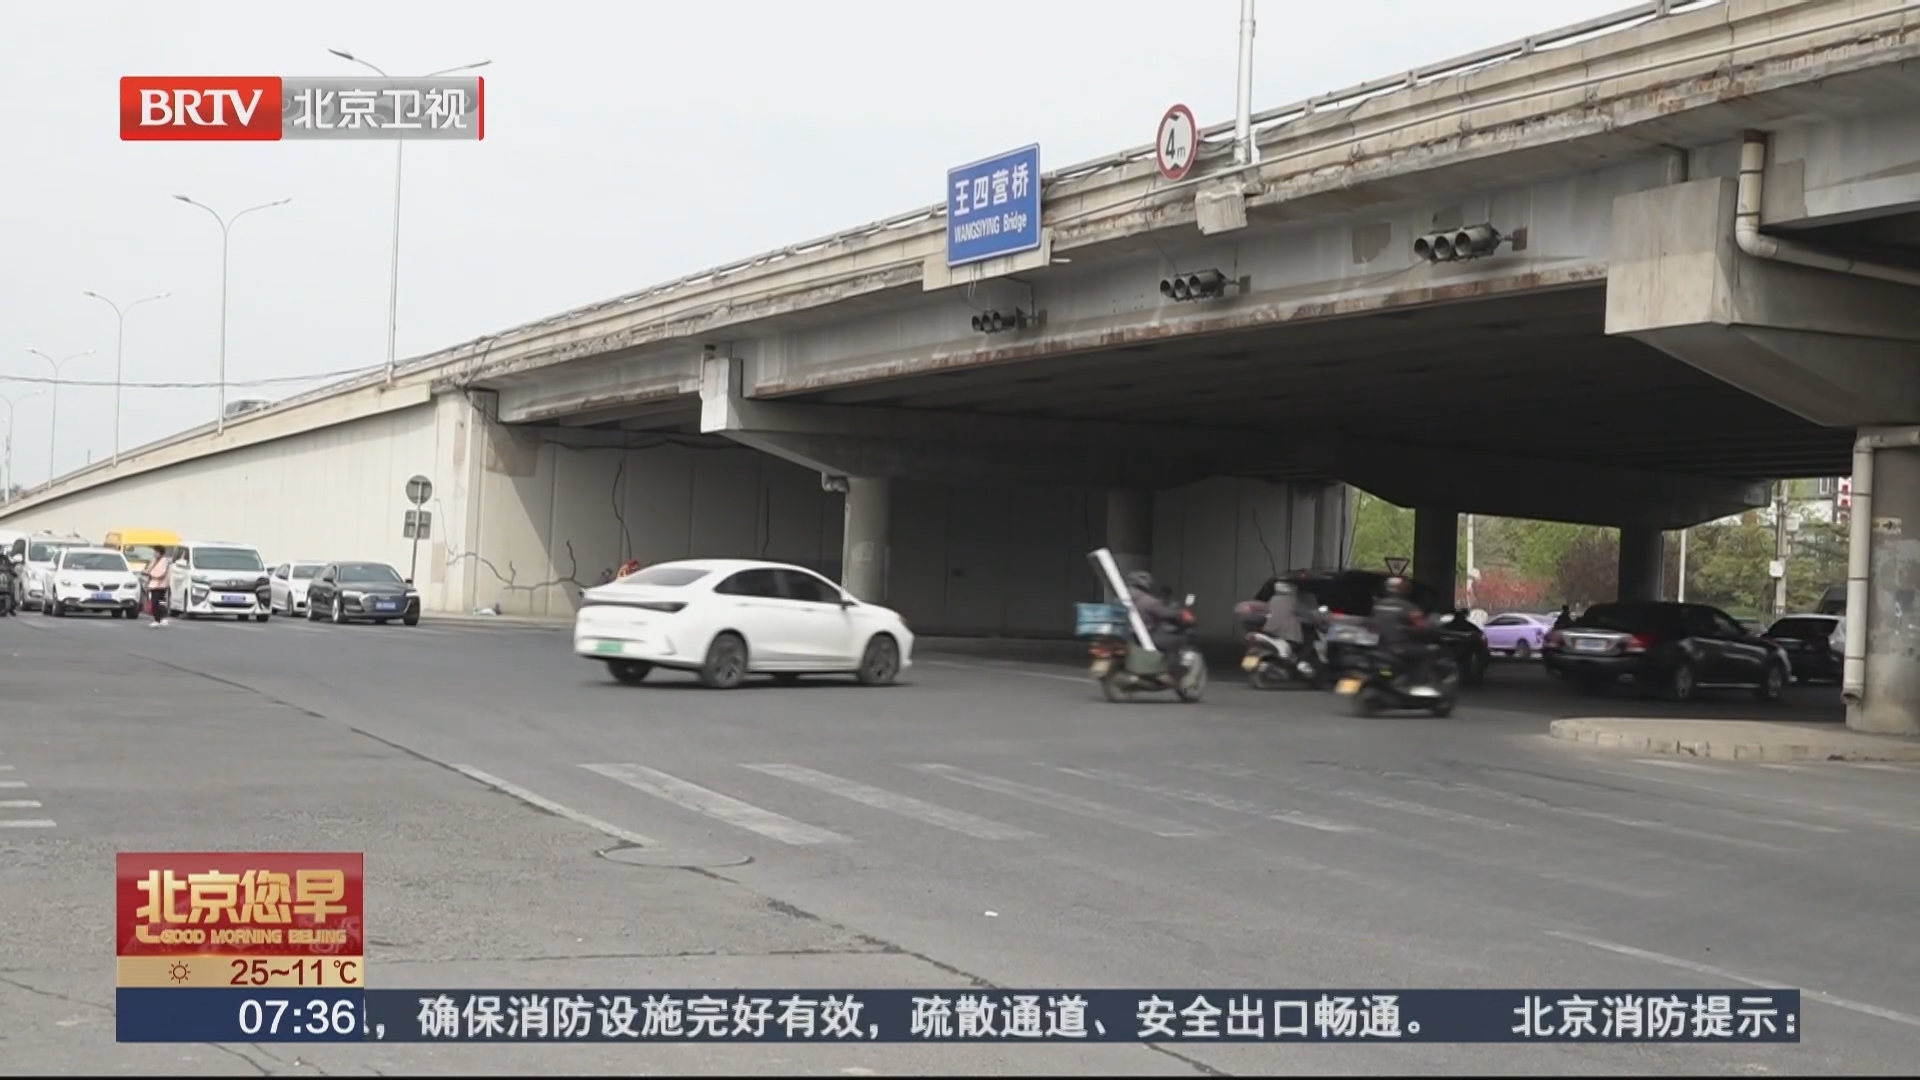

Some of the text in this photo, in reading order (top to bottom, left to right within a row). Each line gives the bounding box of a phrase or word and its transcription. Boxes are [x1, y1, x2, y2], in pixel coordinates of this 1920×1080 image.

[954, 162, 1029, 217] 王四营桥
[954, 211, 1027, 244] WANGSIYING Bridge
